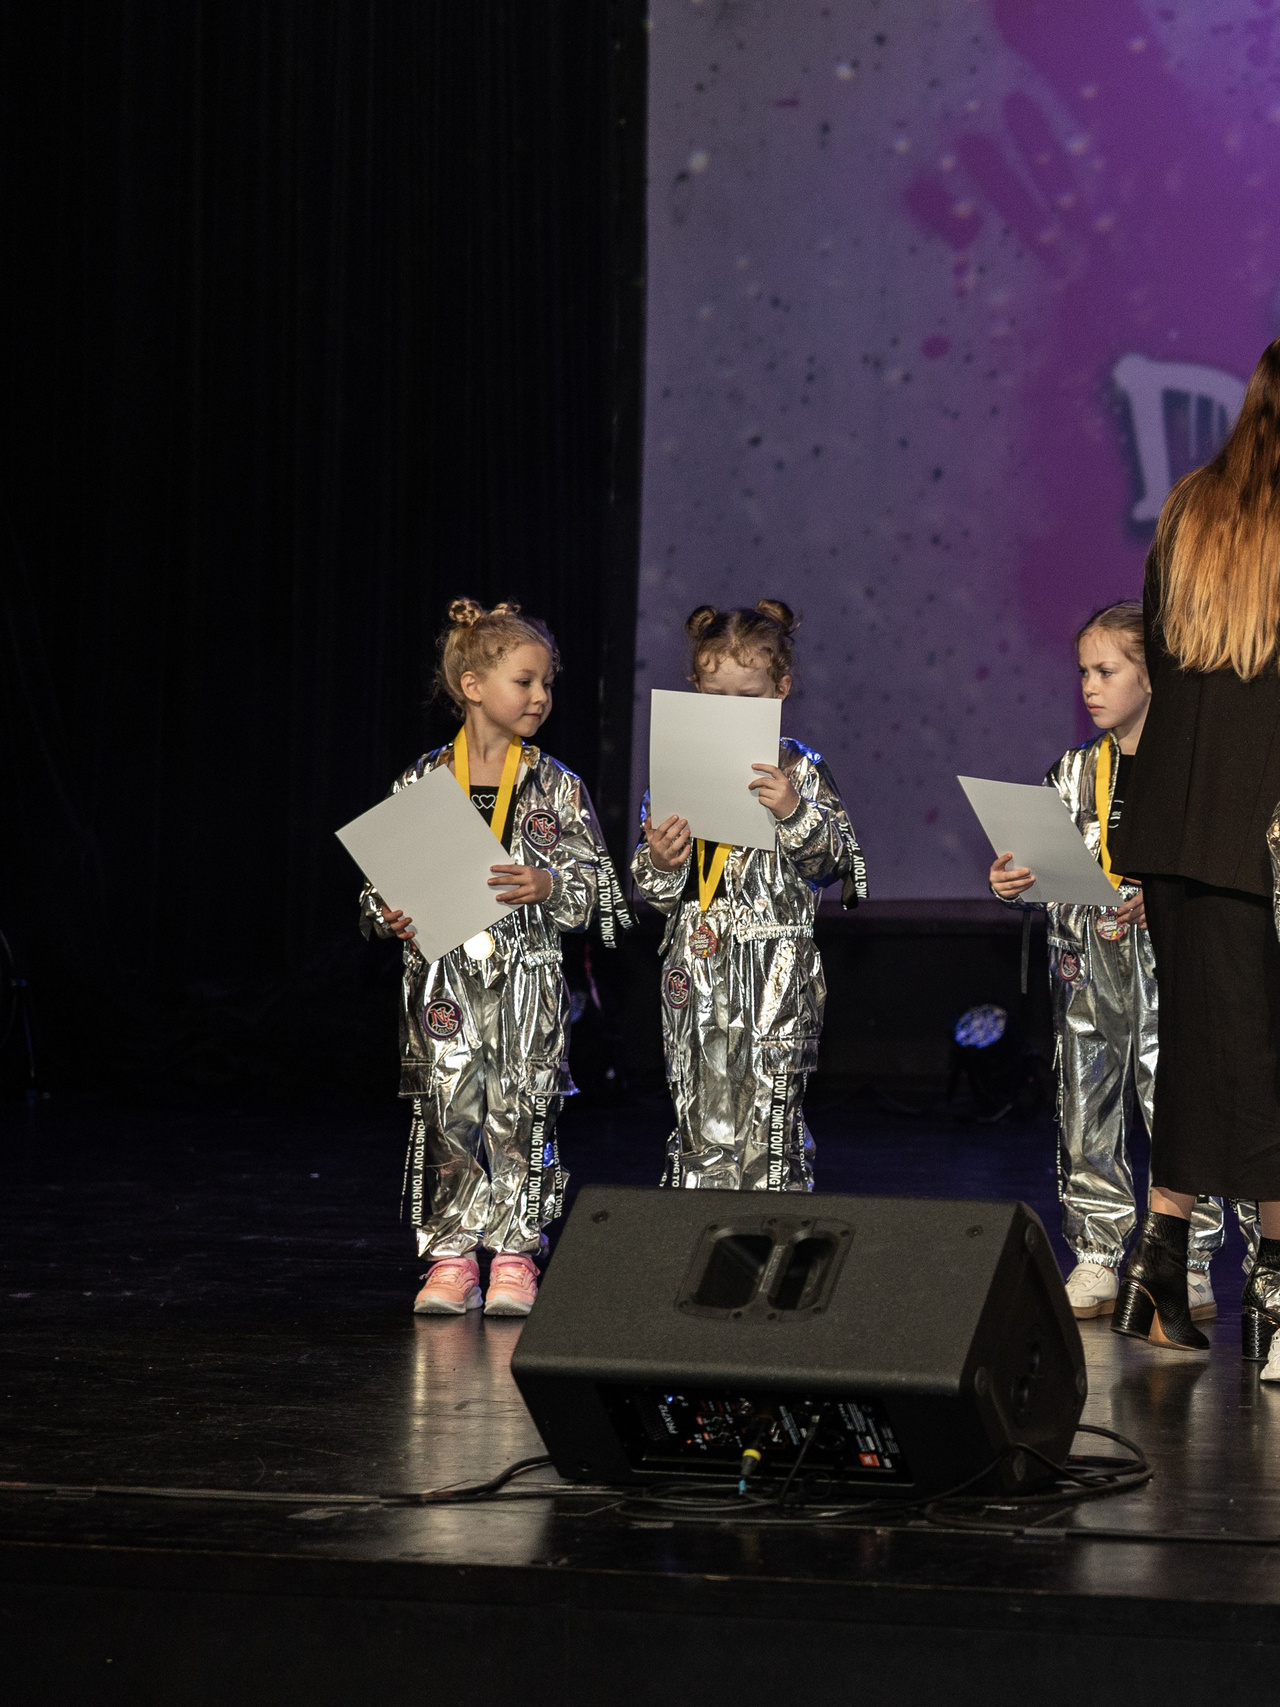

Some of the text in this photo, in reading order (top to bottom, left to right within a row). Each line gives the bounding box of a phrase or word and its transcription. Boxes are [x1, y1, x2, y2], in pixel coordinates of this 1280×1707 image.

[853, 855, 866, 881] TOUY
[599, 888, 613, 912] TOUY
[600, 915, 615, 943] TONG
[774, 1072, 787, 1100] TOUY
[535, 1096, 547, 1118] OUY
[771, 1104, 785, 1131] TONG
[415, 1119, 426, 1144] TONG
[532, 1120, 545, 1146] TONG
[770, 1131, 783, 1157] TOUY
[413, 1144, 425, 1171] TOUY
[530, 1145, 543, 1173] TOUY
[672, 1175, 680, 1187] TO
[768, 1160, 782, 1185] TONG
[412, 1173, 424, 1200] TONG
[528, 1175, 542, 1203] TONG
[411, 1200, 423, 1226] TOUY
[554, 1192, 563, 1219] TONG
